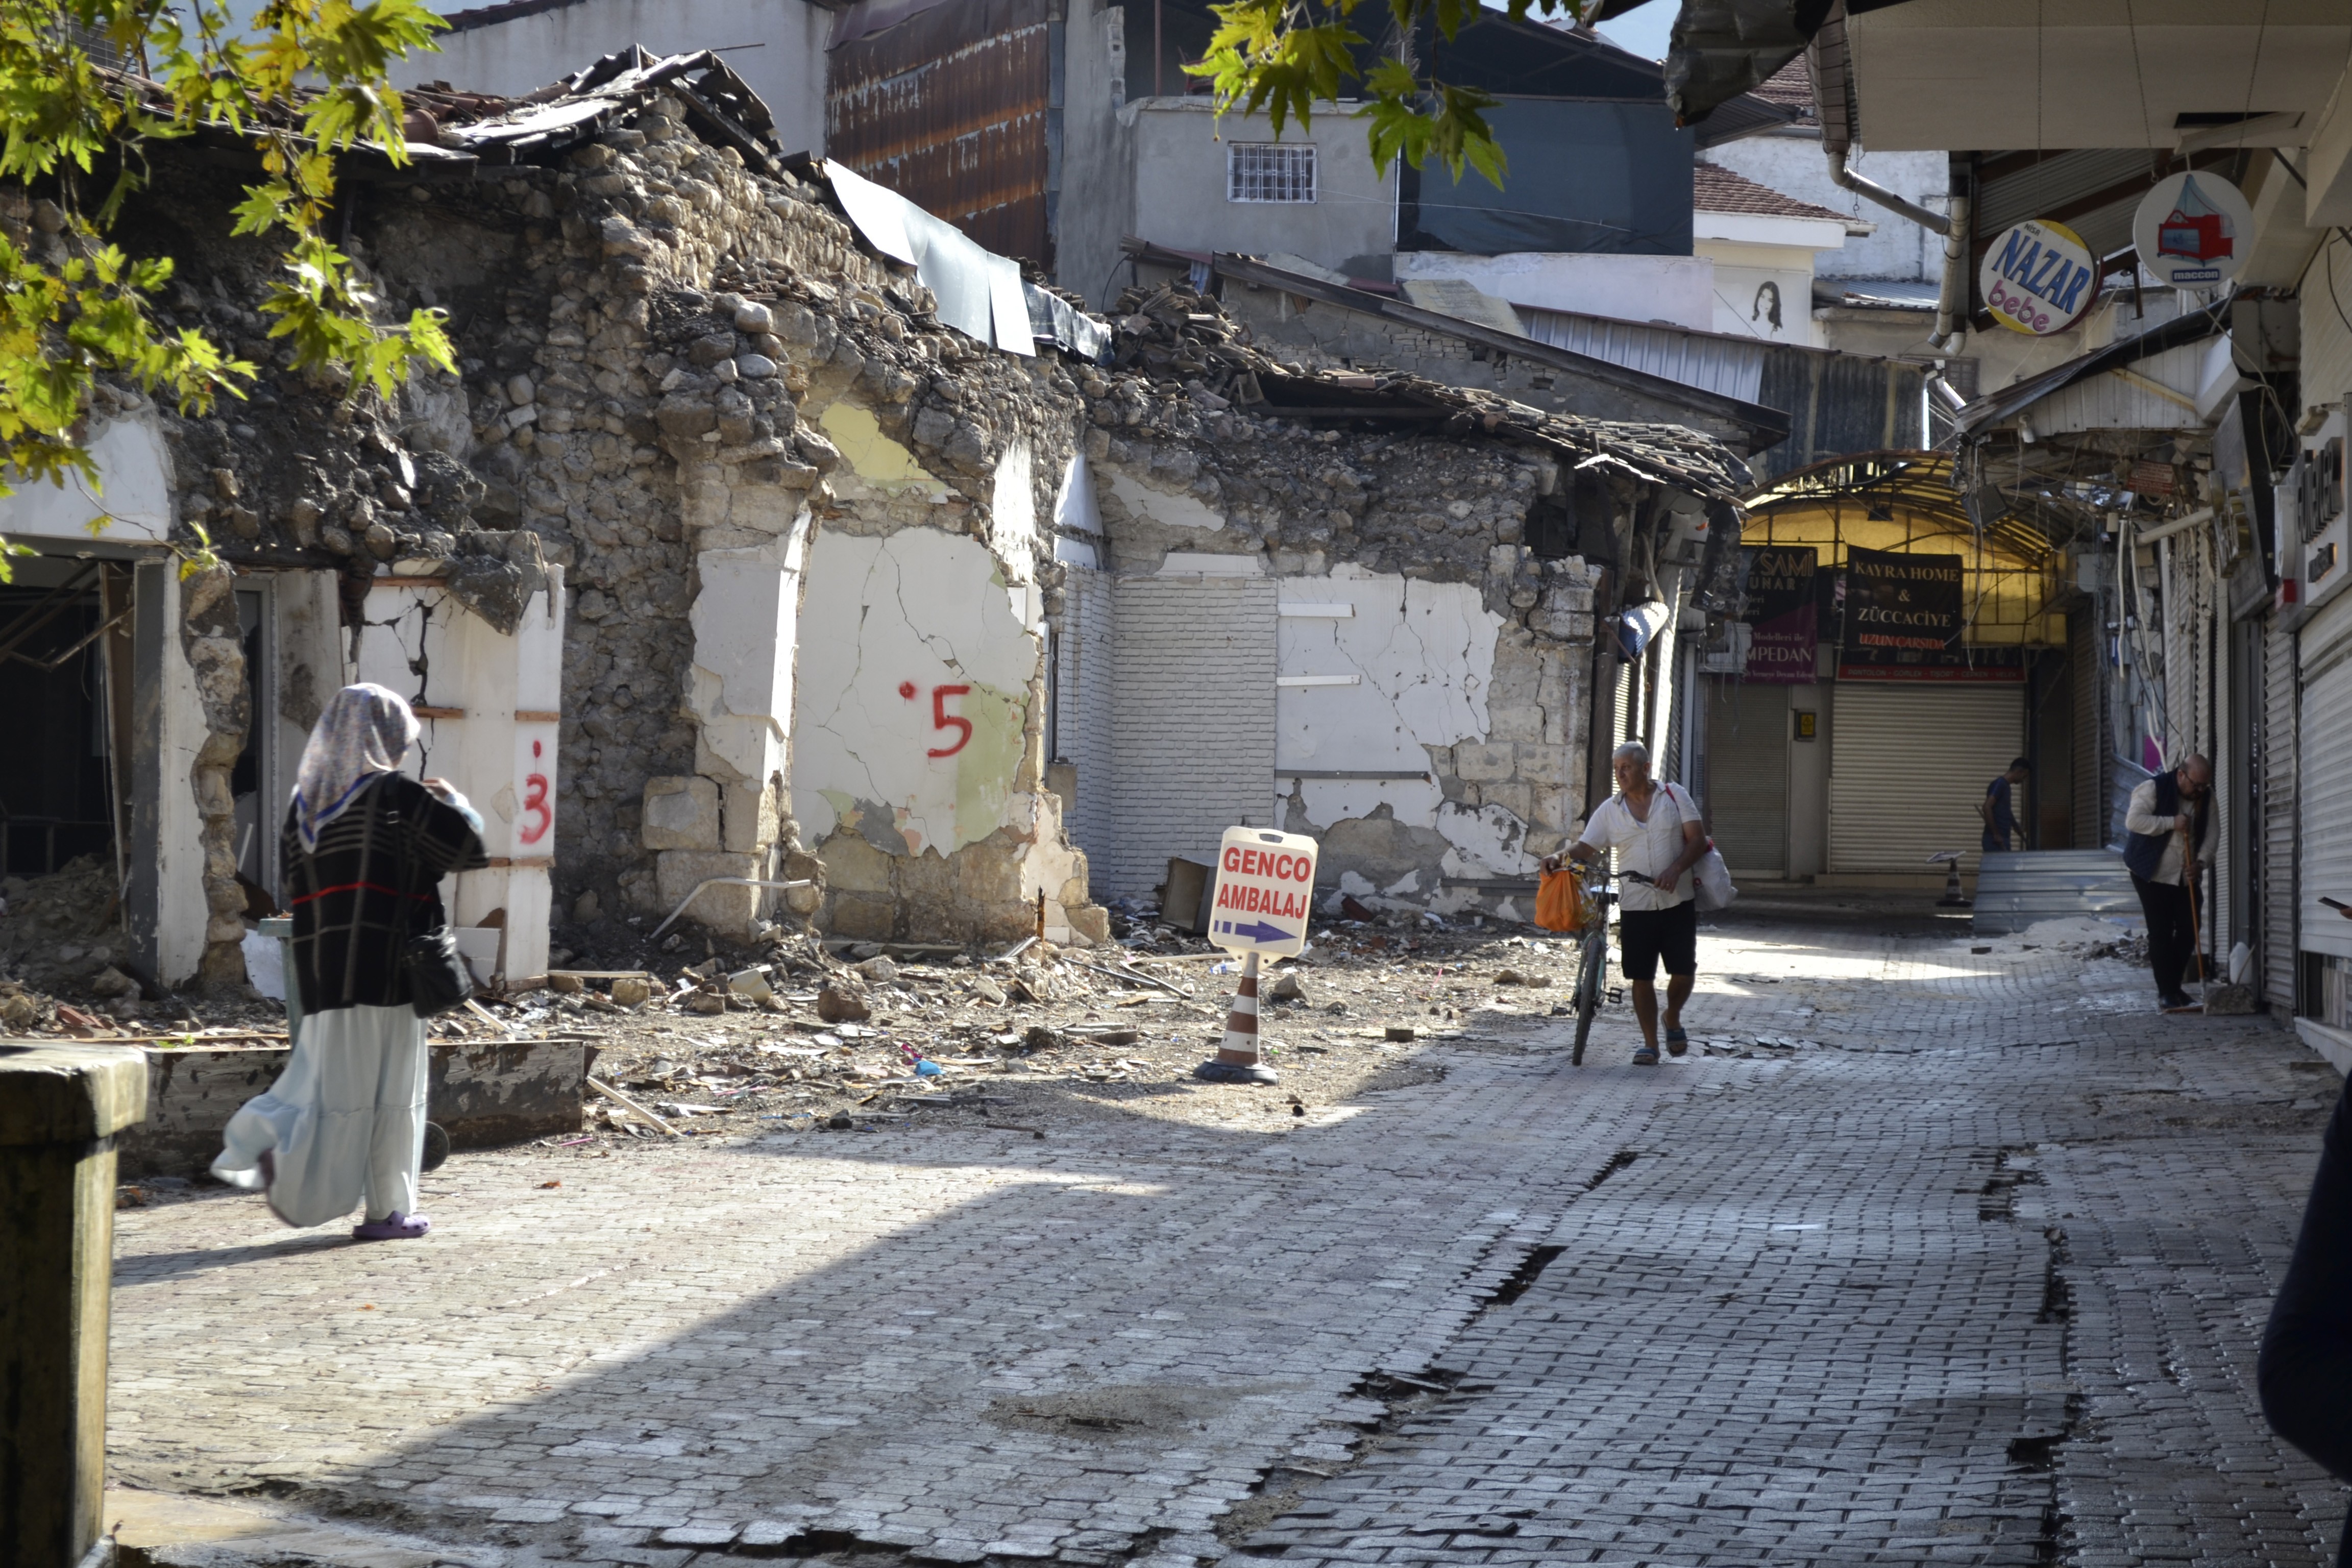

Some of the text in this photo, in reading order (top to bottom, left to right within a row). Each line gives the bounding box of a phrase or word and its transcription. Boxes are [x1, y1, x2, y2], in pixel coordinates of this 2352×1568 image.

[1991, 229, 2090, 314] NAZAR
[2174, 271, 2218, 280] maccon
[1989, 279, 2050, 331] bebe
[1760, 550, 1814, 577] SAMİ
[1855, 560, 1959, 582] KAYRA HOME
[1898, 589, 1910, 602] &
[1858, 606, 1951, 627] ZÜCCACİYE
[1747, 647, 1811, 662] MPEDAN
[1859, 633, 1946, 651] UZUN ÇARŞIDA
[928, 684, 973, 757] 5
[519, 773, 552, 844] 3
[1223, 847, 1311, 882] GENCO
[1217, 884, 1307, 919] AMBALAJ
